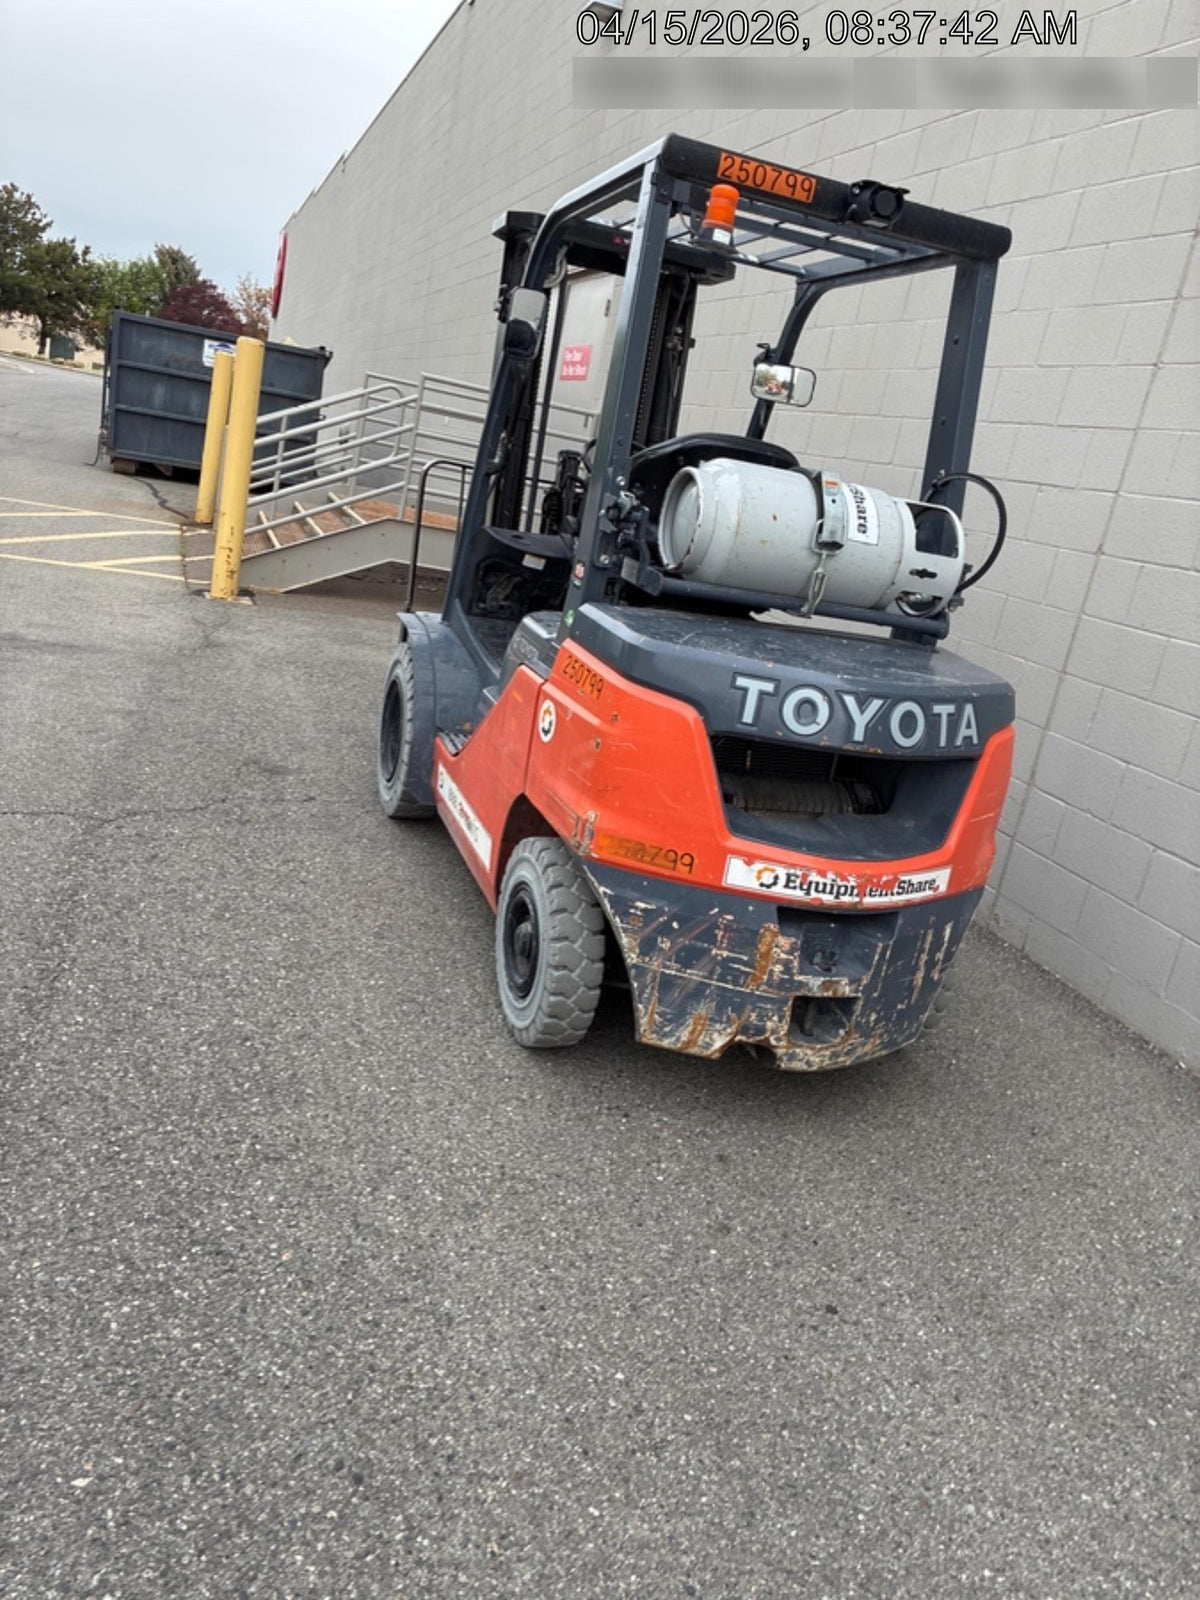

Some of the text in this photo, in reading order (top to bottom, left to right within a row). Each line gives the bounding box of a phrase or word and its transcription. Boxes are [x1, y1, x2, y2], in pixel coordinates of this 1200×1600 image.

[720, 155, 814, 201] 250799
[562, 655, 604, 700] 250799
[733, 675, 980, 749] TOYOTA
